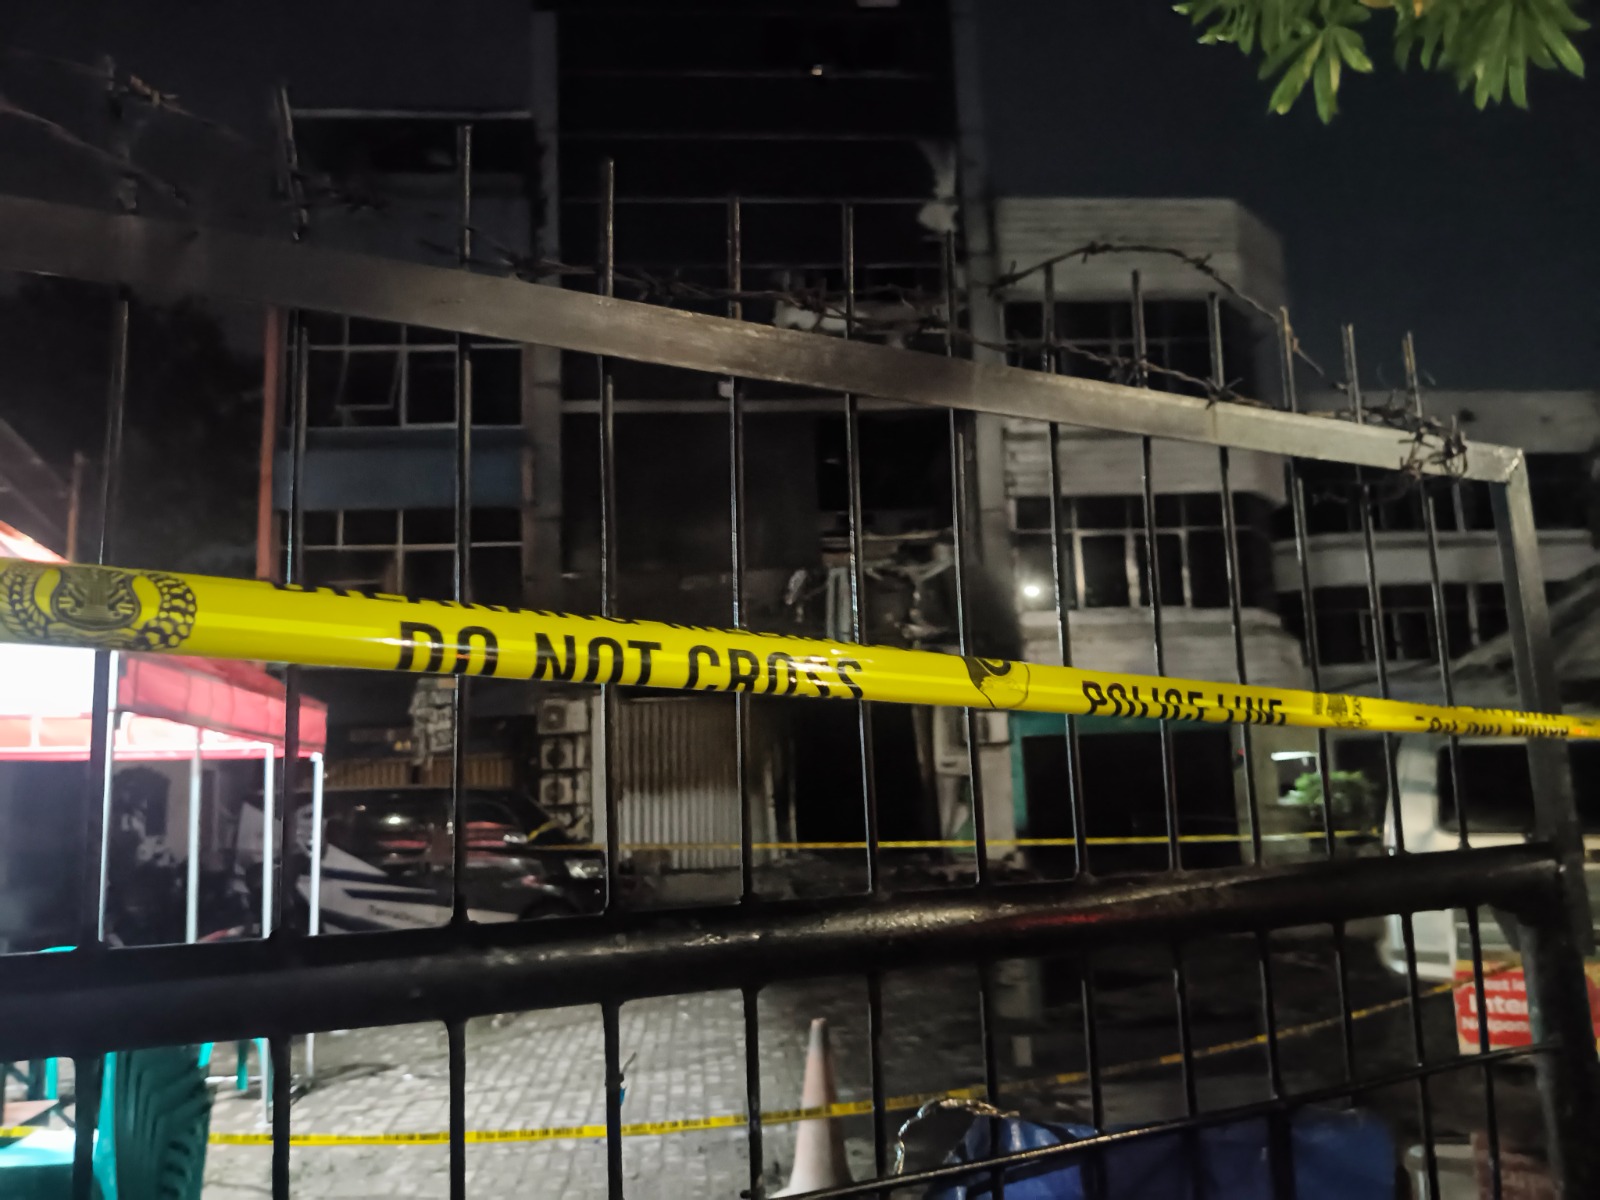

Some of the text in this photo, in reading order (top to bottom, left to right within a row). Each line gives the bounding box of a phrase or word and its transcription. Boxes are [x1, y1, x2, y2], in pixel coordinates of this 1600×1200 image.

[396, 620, 866, 700] DO NOT CROSS
[1082, 680, 1205, 721] POLICE
